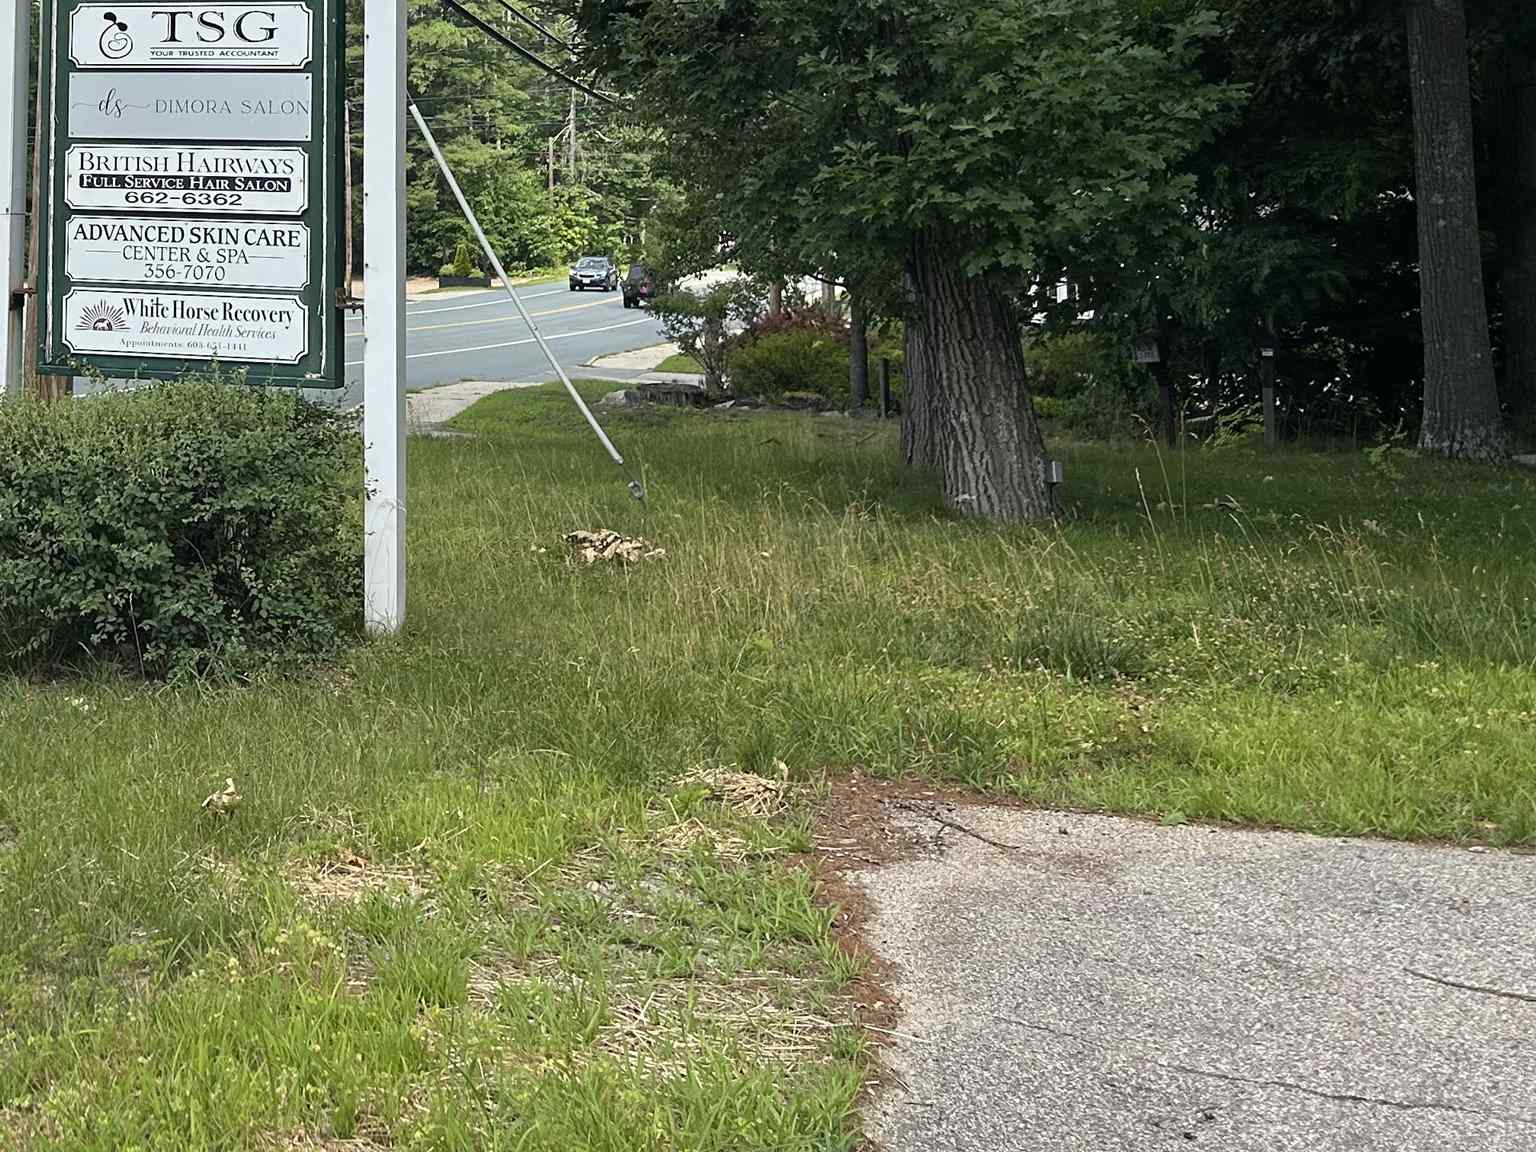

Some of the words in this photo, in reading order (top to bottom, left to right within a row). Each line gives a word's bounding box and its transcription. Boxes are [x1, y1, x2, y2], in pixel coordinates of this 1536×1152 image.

[151, 10, 279, 43] TSG
[154, 100, 231, 114] DIMORA
[241, 100, 309, 115] SALON
[79, 152, 169, 172] BRITISH
[177, 152, 294, 175] HAIRWAYS
[82, 174, 121, 188] FULL
[124, 175, 184, 190] SERVICE
[189, 176, 231, 191] HAIR
[235, 178, 289, 192] SALON
[125, 191, 243, 206] 662-6362
[73, 223, 185, 244] ADVANCED
[189, 226, 239, 246] SKIN
[244, 229, 301, 248] CARE
[122, 245, 190, 263] CENTER
[196, 248, 210, 263] &
[216, 249, 250, 265] SPA
[144, 264, 226, 281] 356-7070
[123, 297, 170, 319] White
[173, 301, 220, 321] Horse
[222, 303, 295, 330] Recovery
[140, 321, 197, 337] Behavioral
[197, 323, 233, 338] Health
[236, 325, 277, 340] Services
